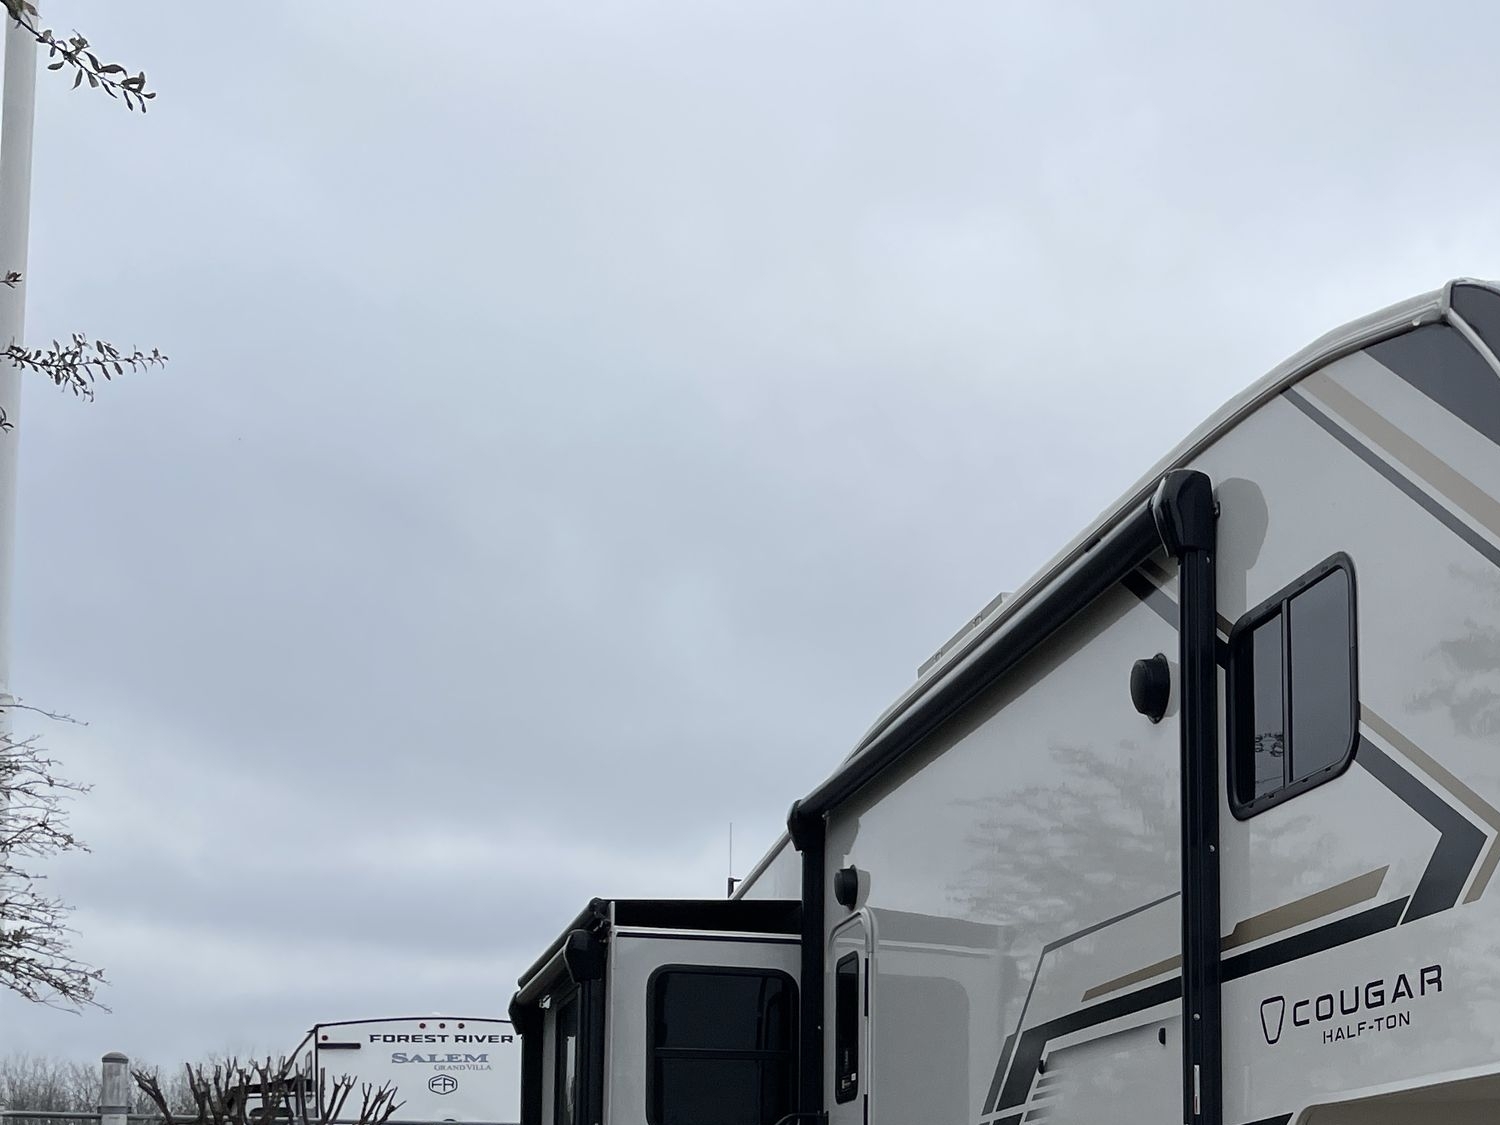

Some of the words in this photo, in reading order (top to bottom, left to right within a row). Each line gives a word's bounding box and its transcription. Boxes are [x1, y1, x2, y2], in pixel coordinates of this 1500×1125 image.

[1293, 964, 1442, 1027] COUGAR
[369, 1034, 450, 1043] FOREST
[454, 1034, 514, 1043] RIVER
[1323, 1011, 1410, 1044] HALF-TON
[391, 1053, 489, 1064] SALEM
